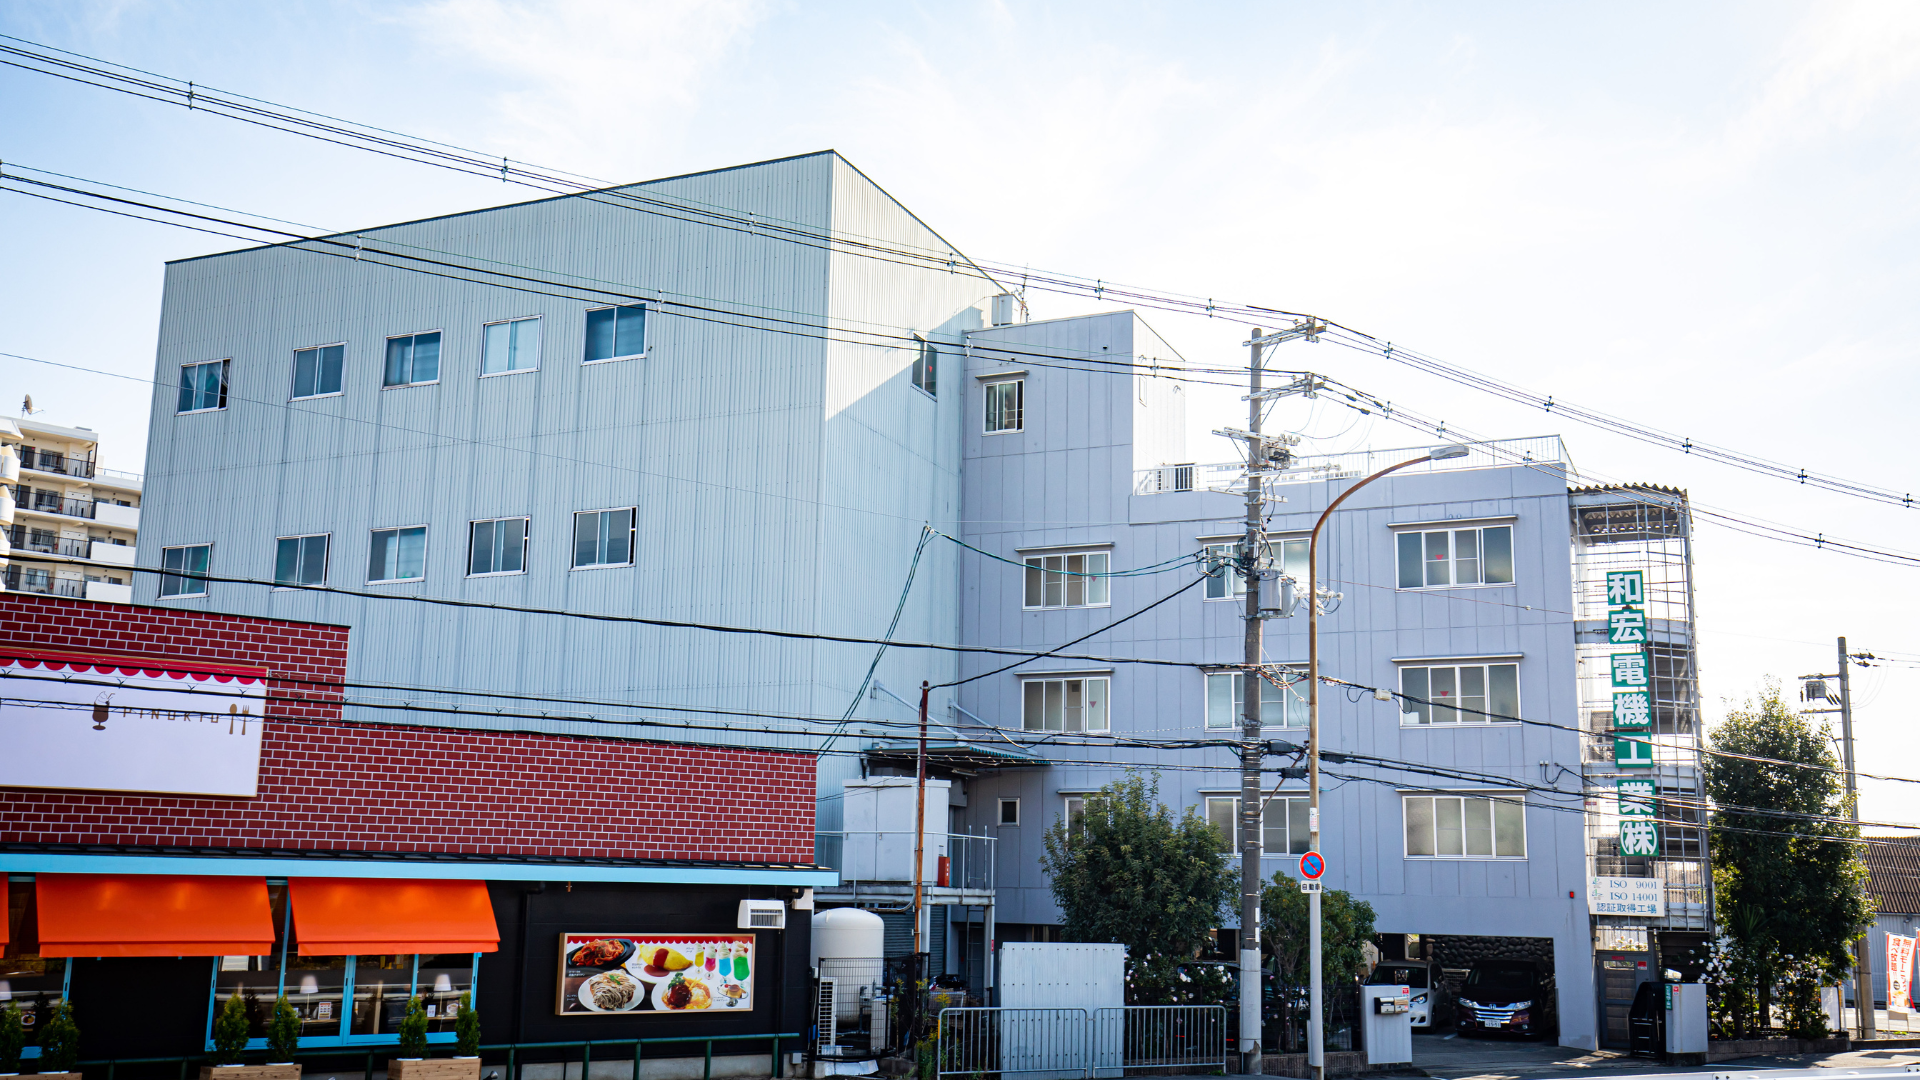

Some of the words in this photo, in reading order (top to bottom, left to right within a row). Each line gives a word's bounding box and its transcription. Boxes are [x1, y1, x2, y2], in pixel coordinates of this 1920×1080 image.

[1610, 880, 1628, 888] ISO
[1635, 881, 1658, 890] 9001
[1610, 892, 1628, 900] ISO
[1632, 893, 1658, 901] 14001
[1596, 902, 1657, 914] 認証取得工場
